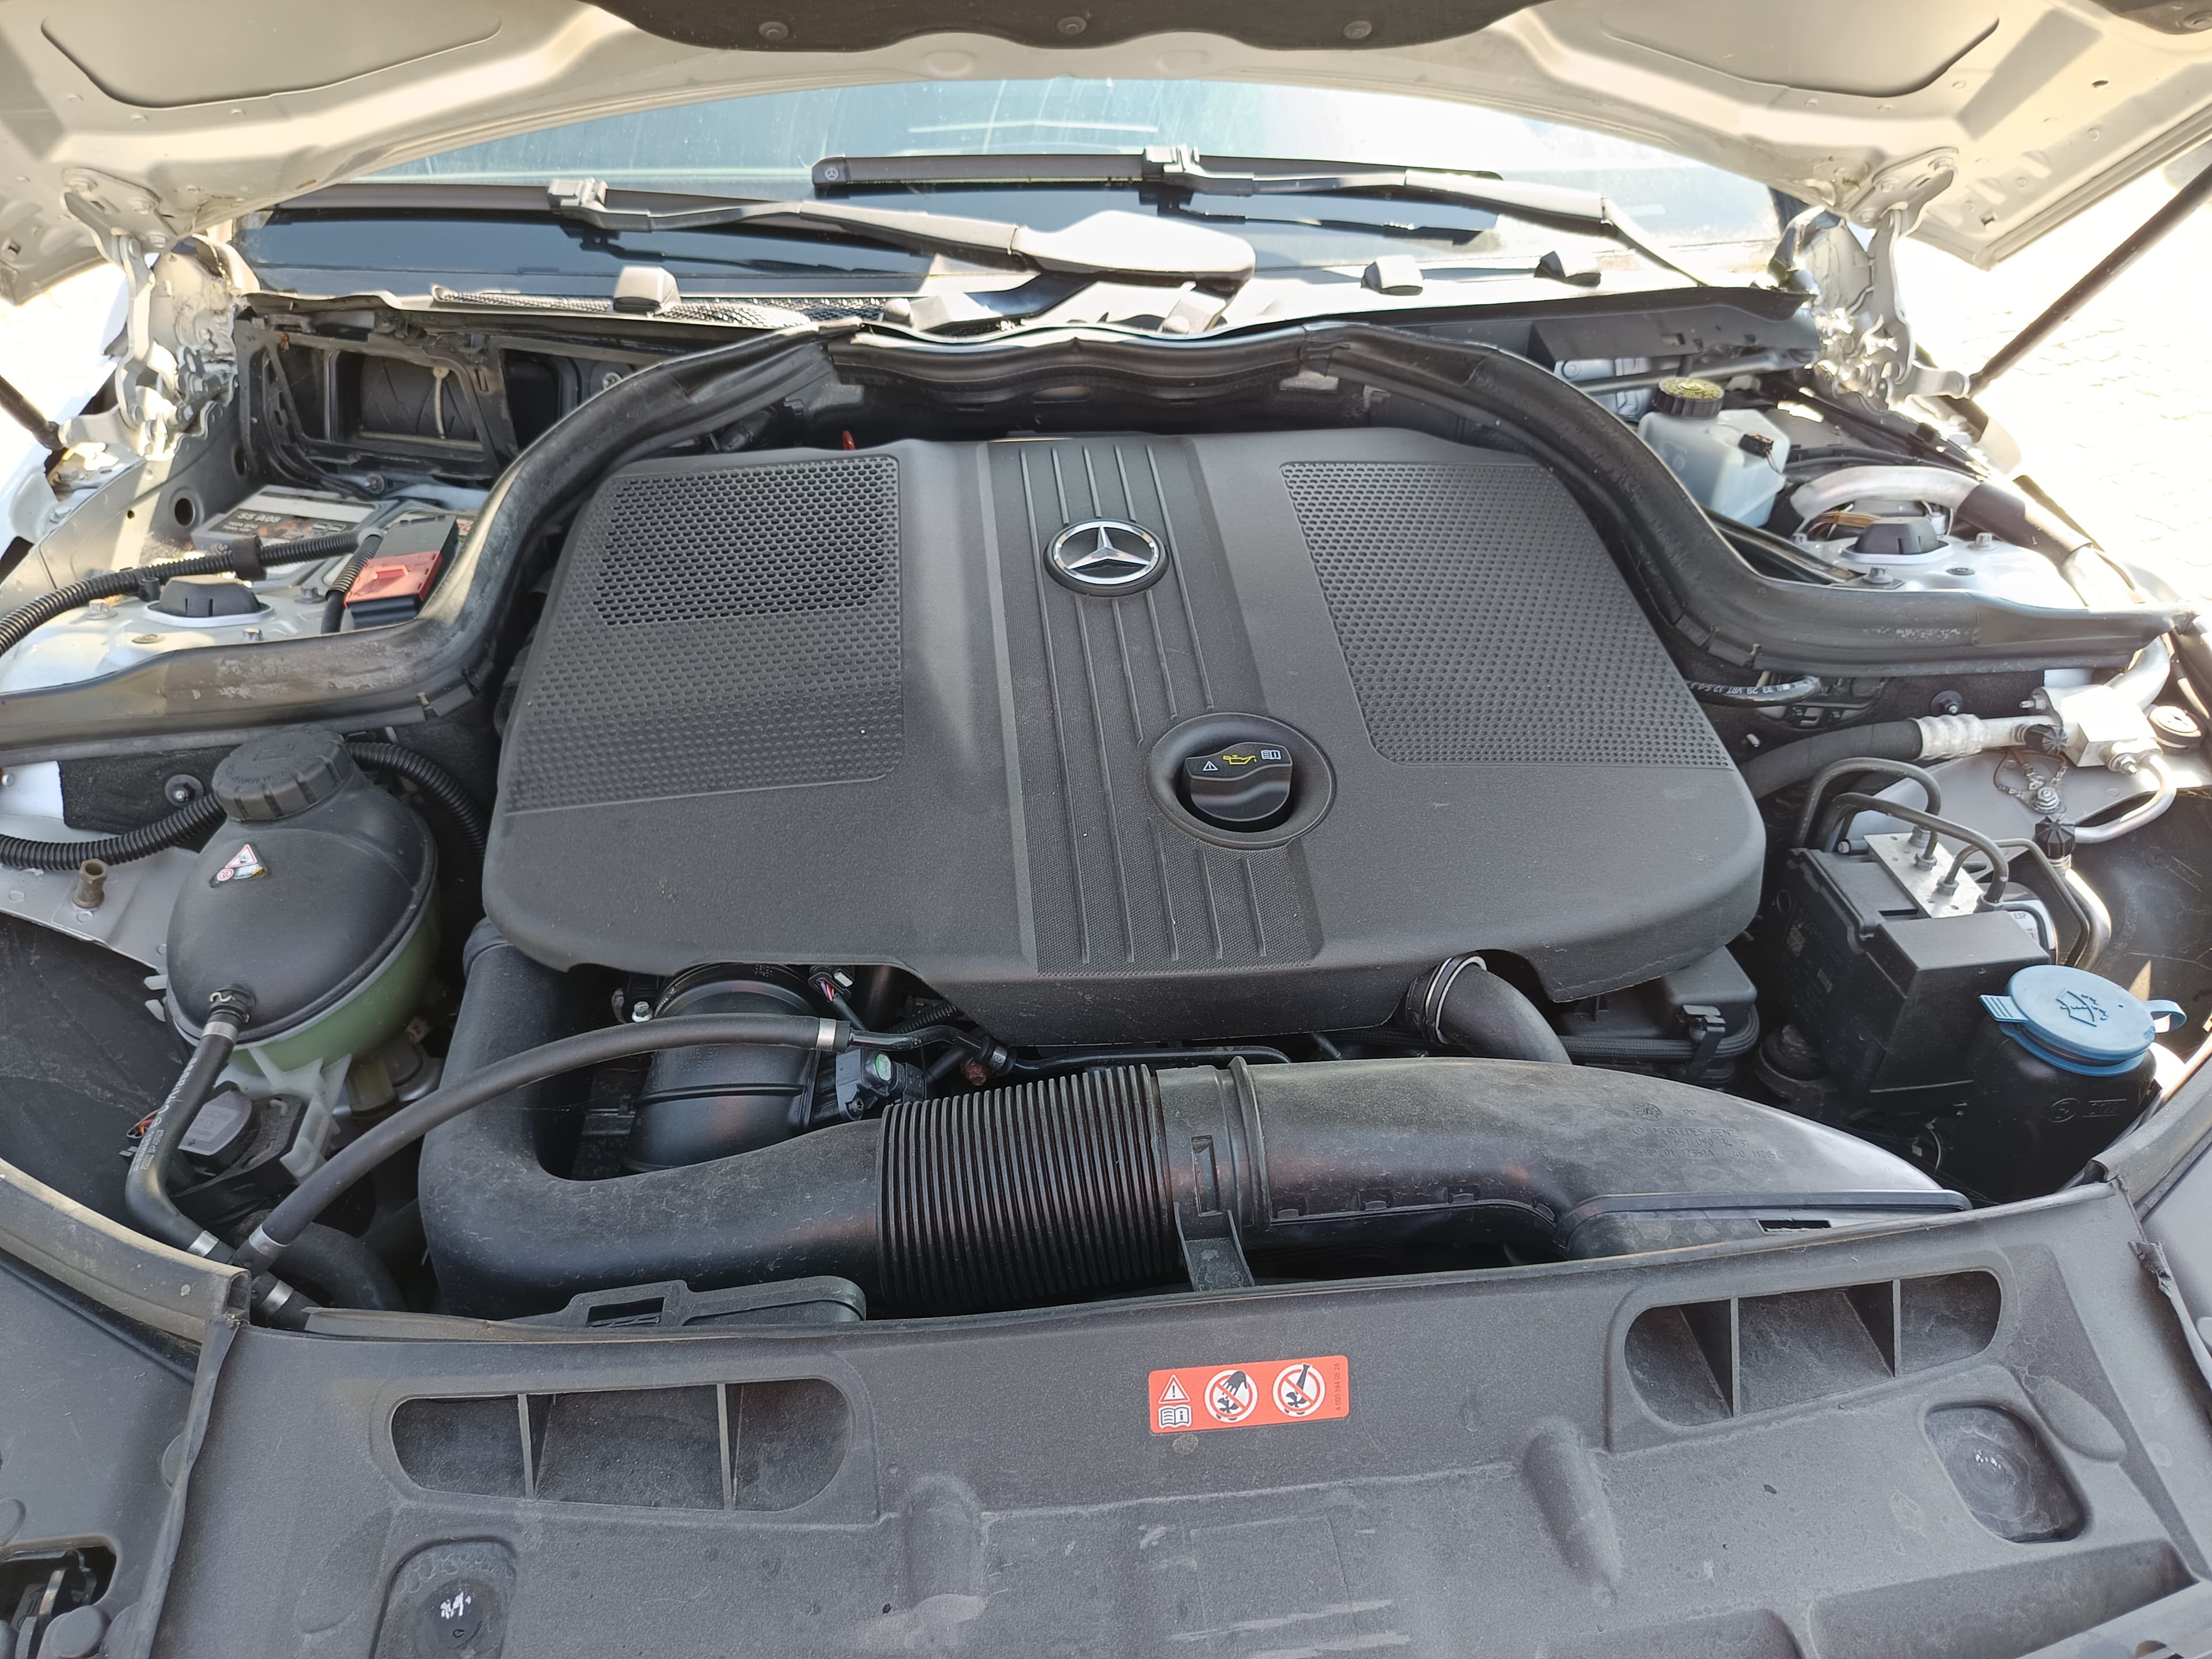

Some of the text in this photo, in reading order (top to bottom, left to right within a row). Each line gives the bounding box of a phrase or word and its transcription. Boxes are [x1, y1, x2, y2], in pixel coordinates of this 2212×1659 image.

[1652, 1127, 1738, 1138] MERCEDES-BENZ
[1334, 1363, 1340, 1371] 26
[1334, 1372, 1340, 1380] 05
